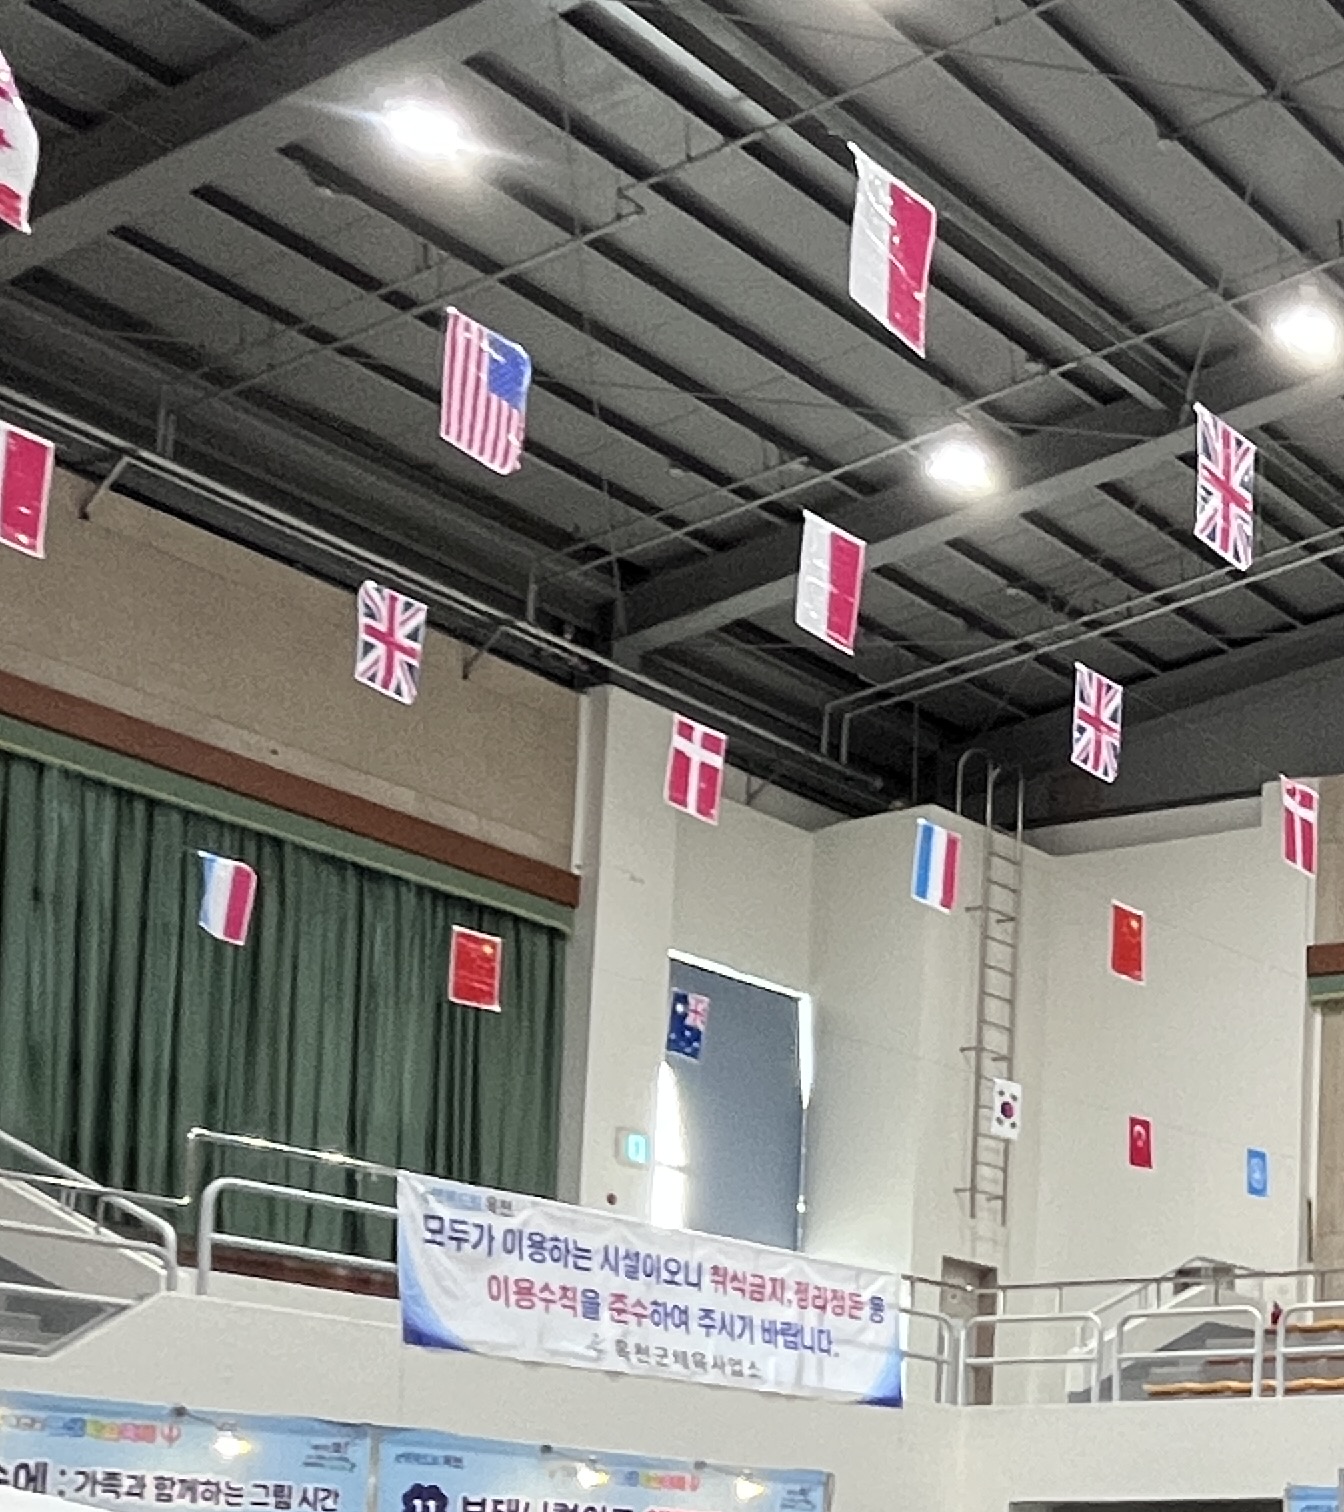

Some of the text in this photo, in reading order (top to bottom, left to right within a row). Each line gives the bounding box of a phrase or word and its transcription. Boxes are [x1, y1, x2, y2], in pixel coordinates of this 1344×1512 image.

[423, 1213, 495, 1257] 모두가
[502, 1228, 592, 1272] 이용하는
[600, 1244, 702, 1291] 시설이오니
[487, 1274, 840, 1358] 이용수칙을 준수하여 주시기 바랍니다.
[0, 1460, 48, 1494] 에
[74, 1470, 147, 1501] 가족과
[153, 1475, 244, 1507] 함께하는
[250, 1483, 293, 1510] 그림
[298, 1487, 340, 1512] 시간
